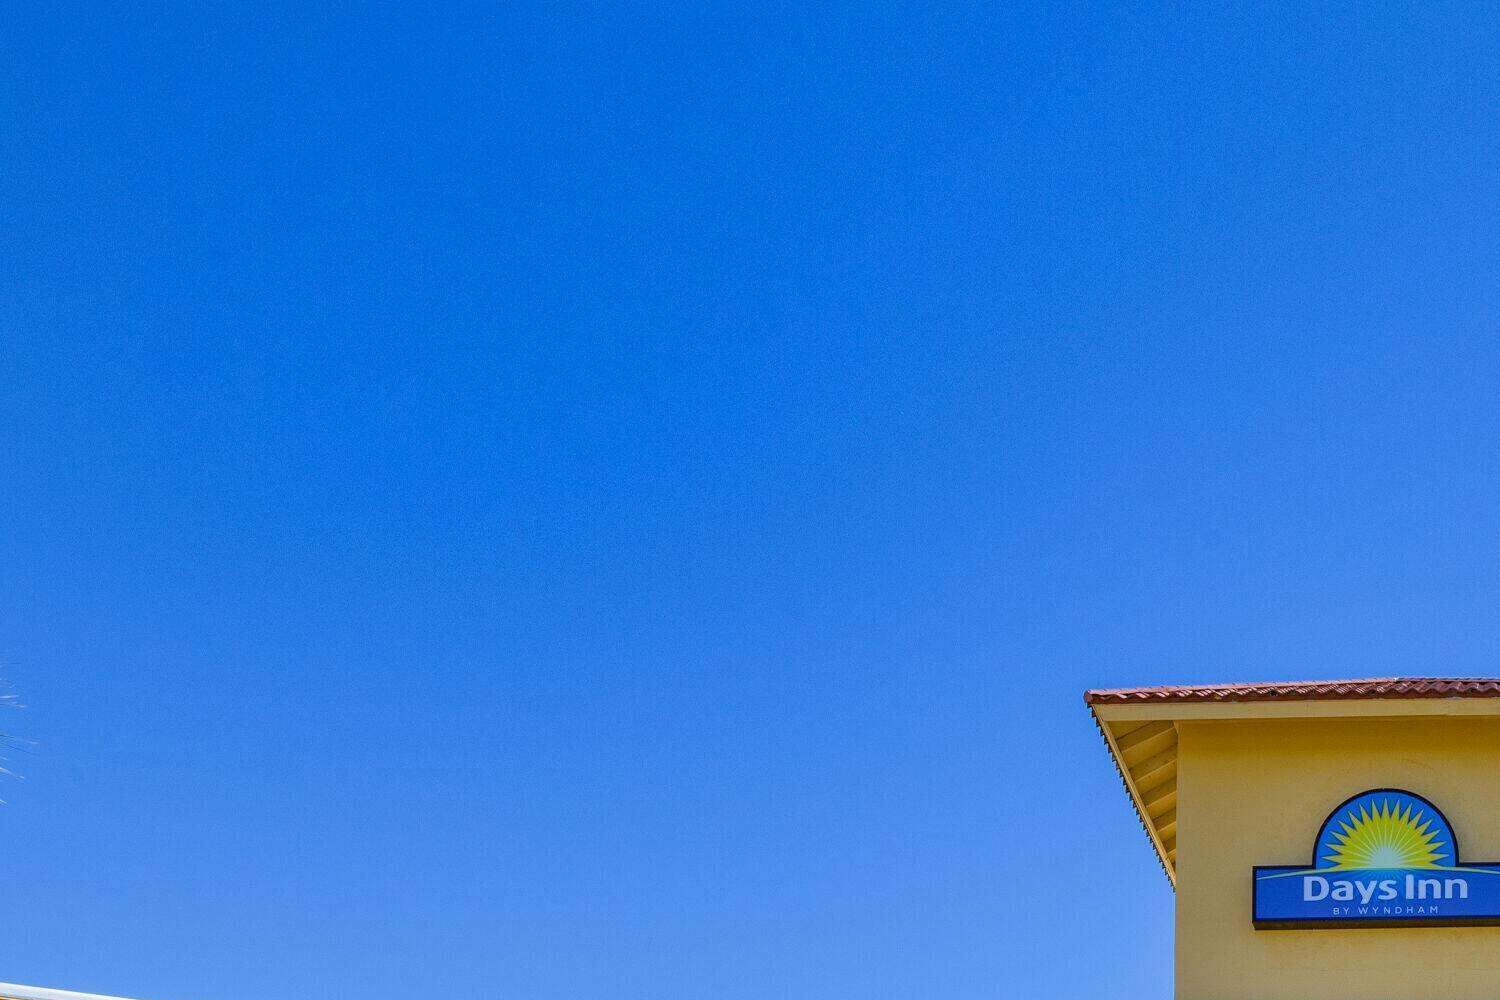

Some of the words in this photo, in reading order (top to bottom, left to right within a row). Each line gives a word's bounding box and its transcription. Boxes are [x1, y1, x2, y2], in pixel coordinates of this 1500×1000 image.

[1303, 875, 1398, 904] Days
[1405, 874, 1469, 900] Inn
[1332, 907, 1350, 915] BY
[1358, 905, 1439, 915] WYNDHAM
